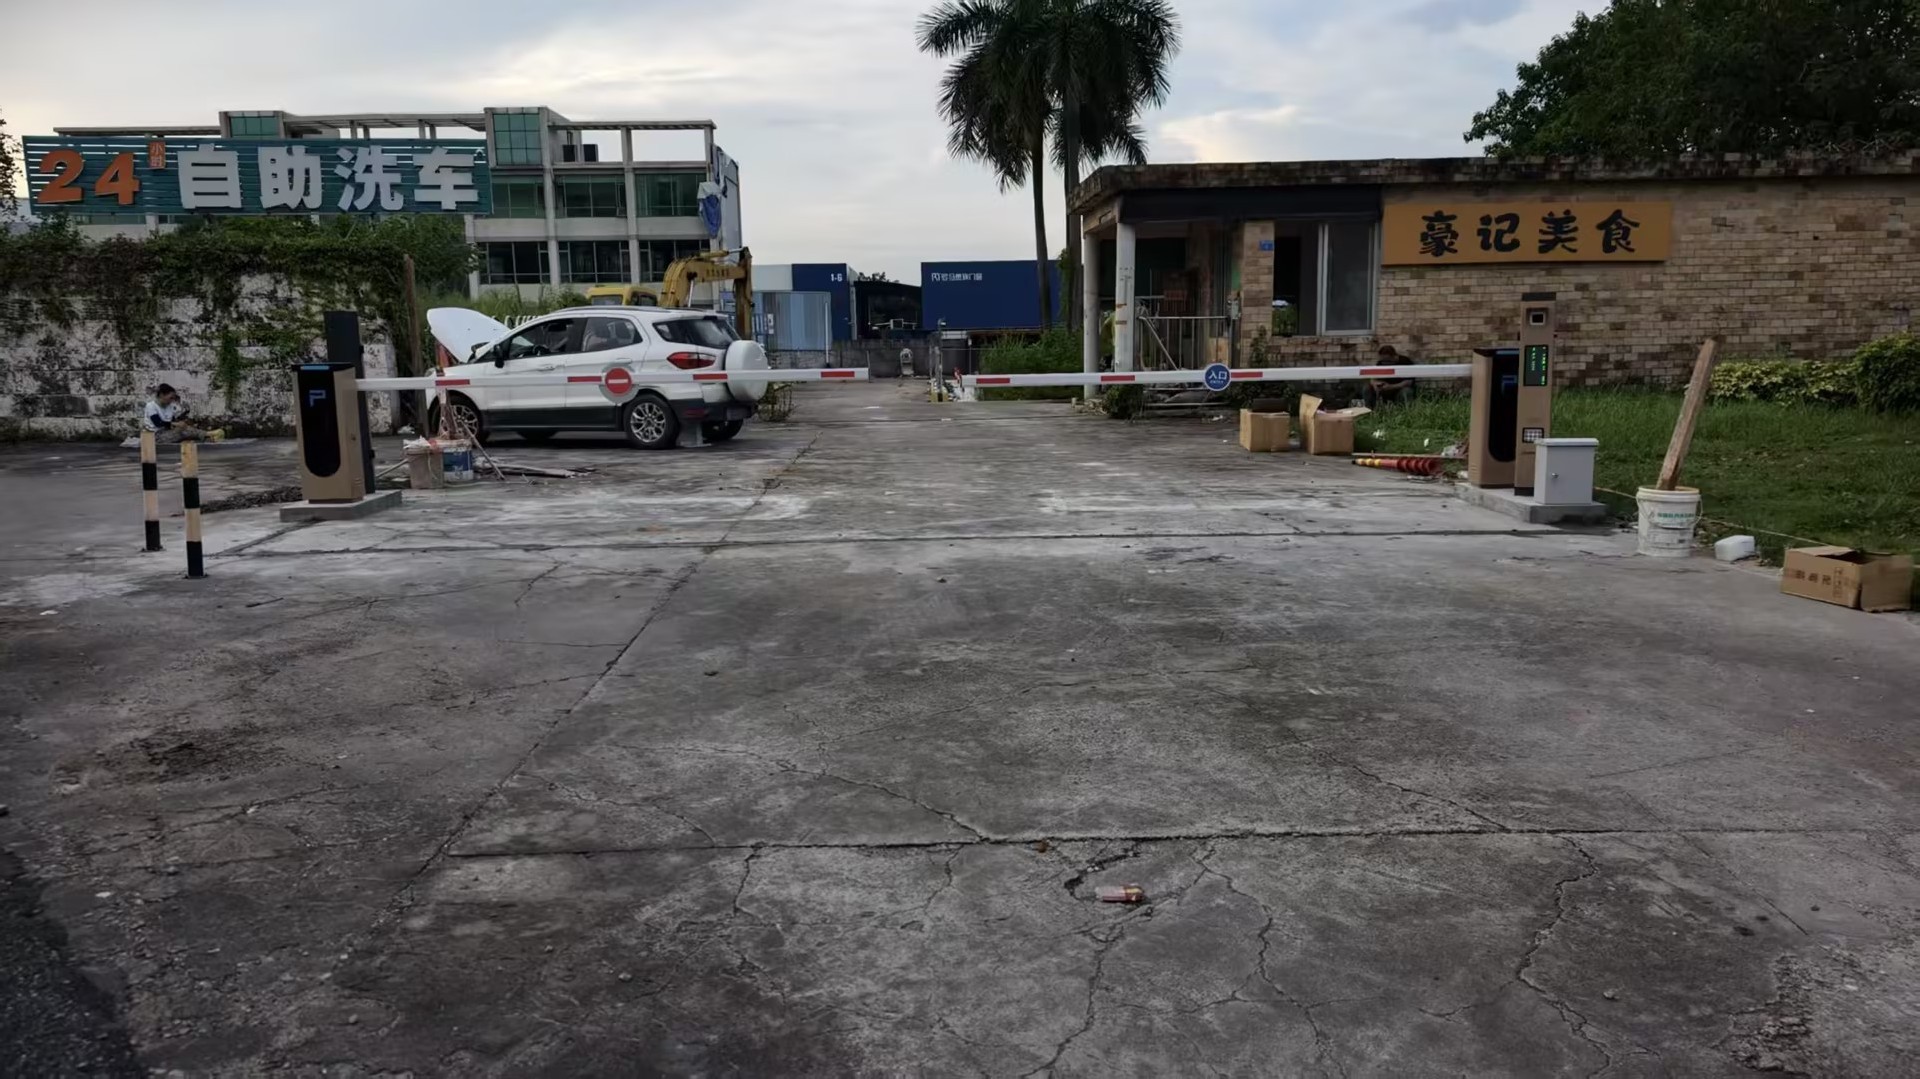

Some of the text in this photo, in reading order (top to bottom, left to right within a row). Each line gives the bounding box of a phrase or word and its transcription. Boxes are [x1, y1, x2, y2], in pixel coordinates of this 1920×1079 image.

[36, 149, 140, 205] 24
[149, 143, 165, 169] 小时
[177, 143, 479, 211] 自助洗车
[1419, 209, 1640, 257] 豪记美食
[1208, 370, 1228, 380] 入口
